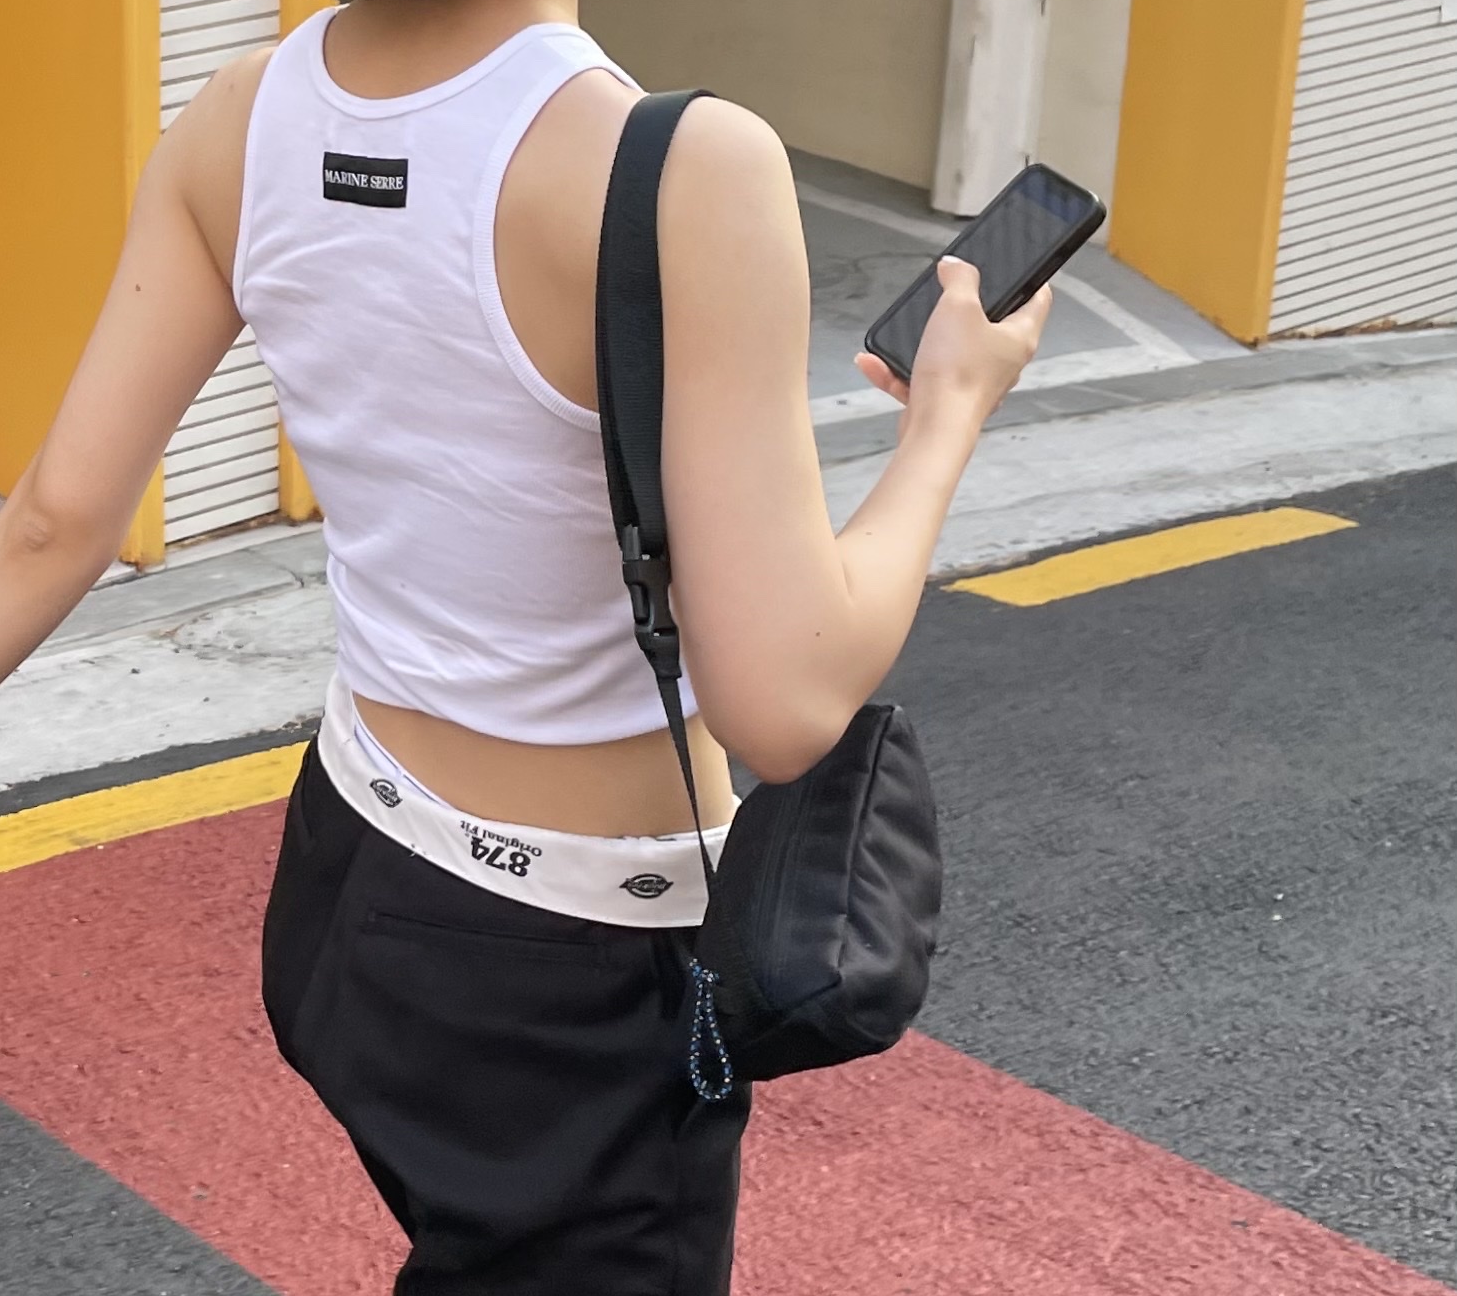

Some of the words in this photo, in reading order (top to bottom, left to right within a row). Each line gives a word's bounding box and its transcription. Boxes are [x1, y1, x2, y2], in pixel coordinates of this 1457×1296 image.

[324, 169, 369, 188] MARINE
[370, 175, 404, 190] SERRE
[460, 820, 479, 836] Fit
[483, 828, 542, 857] Original
[471, 835, 531, 877] 874
